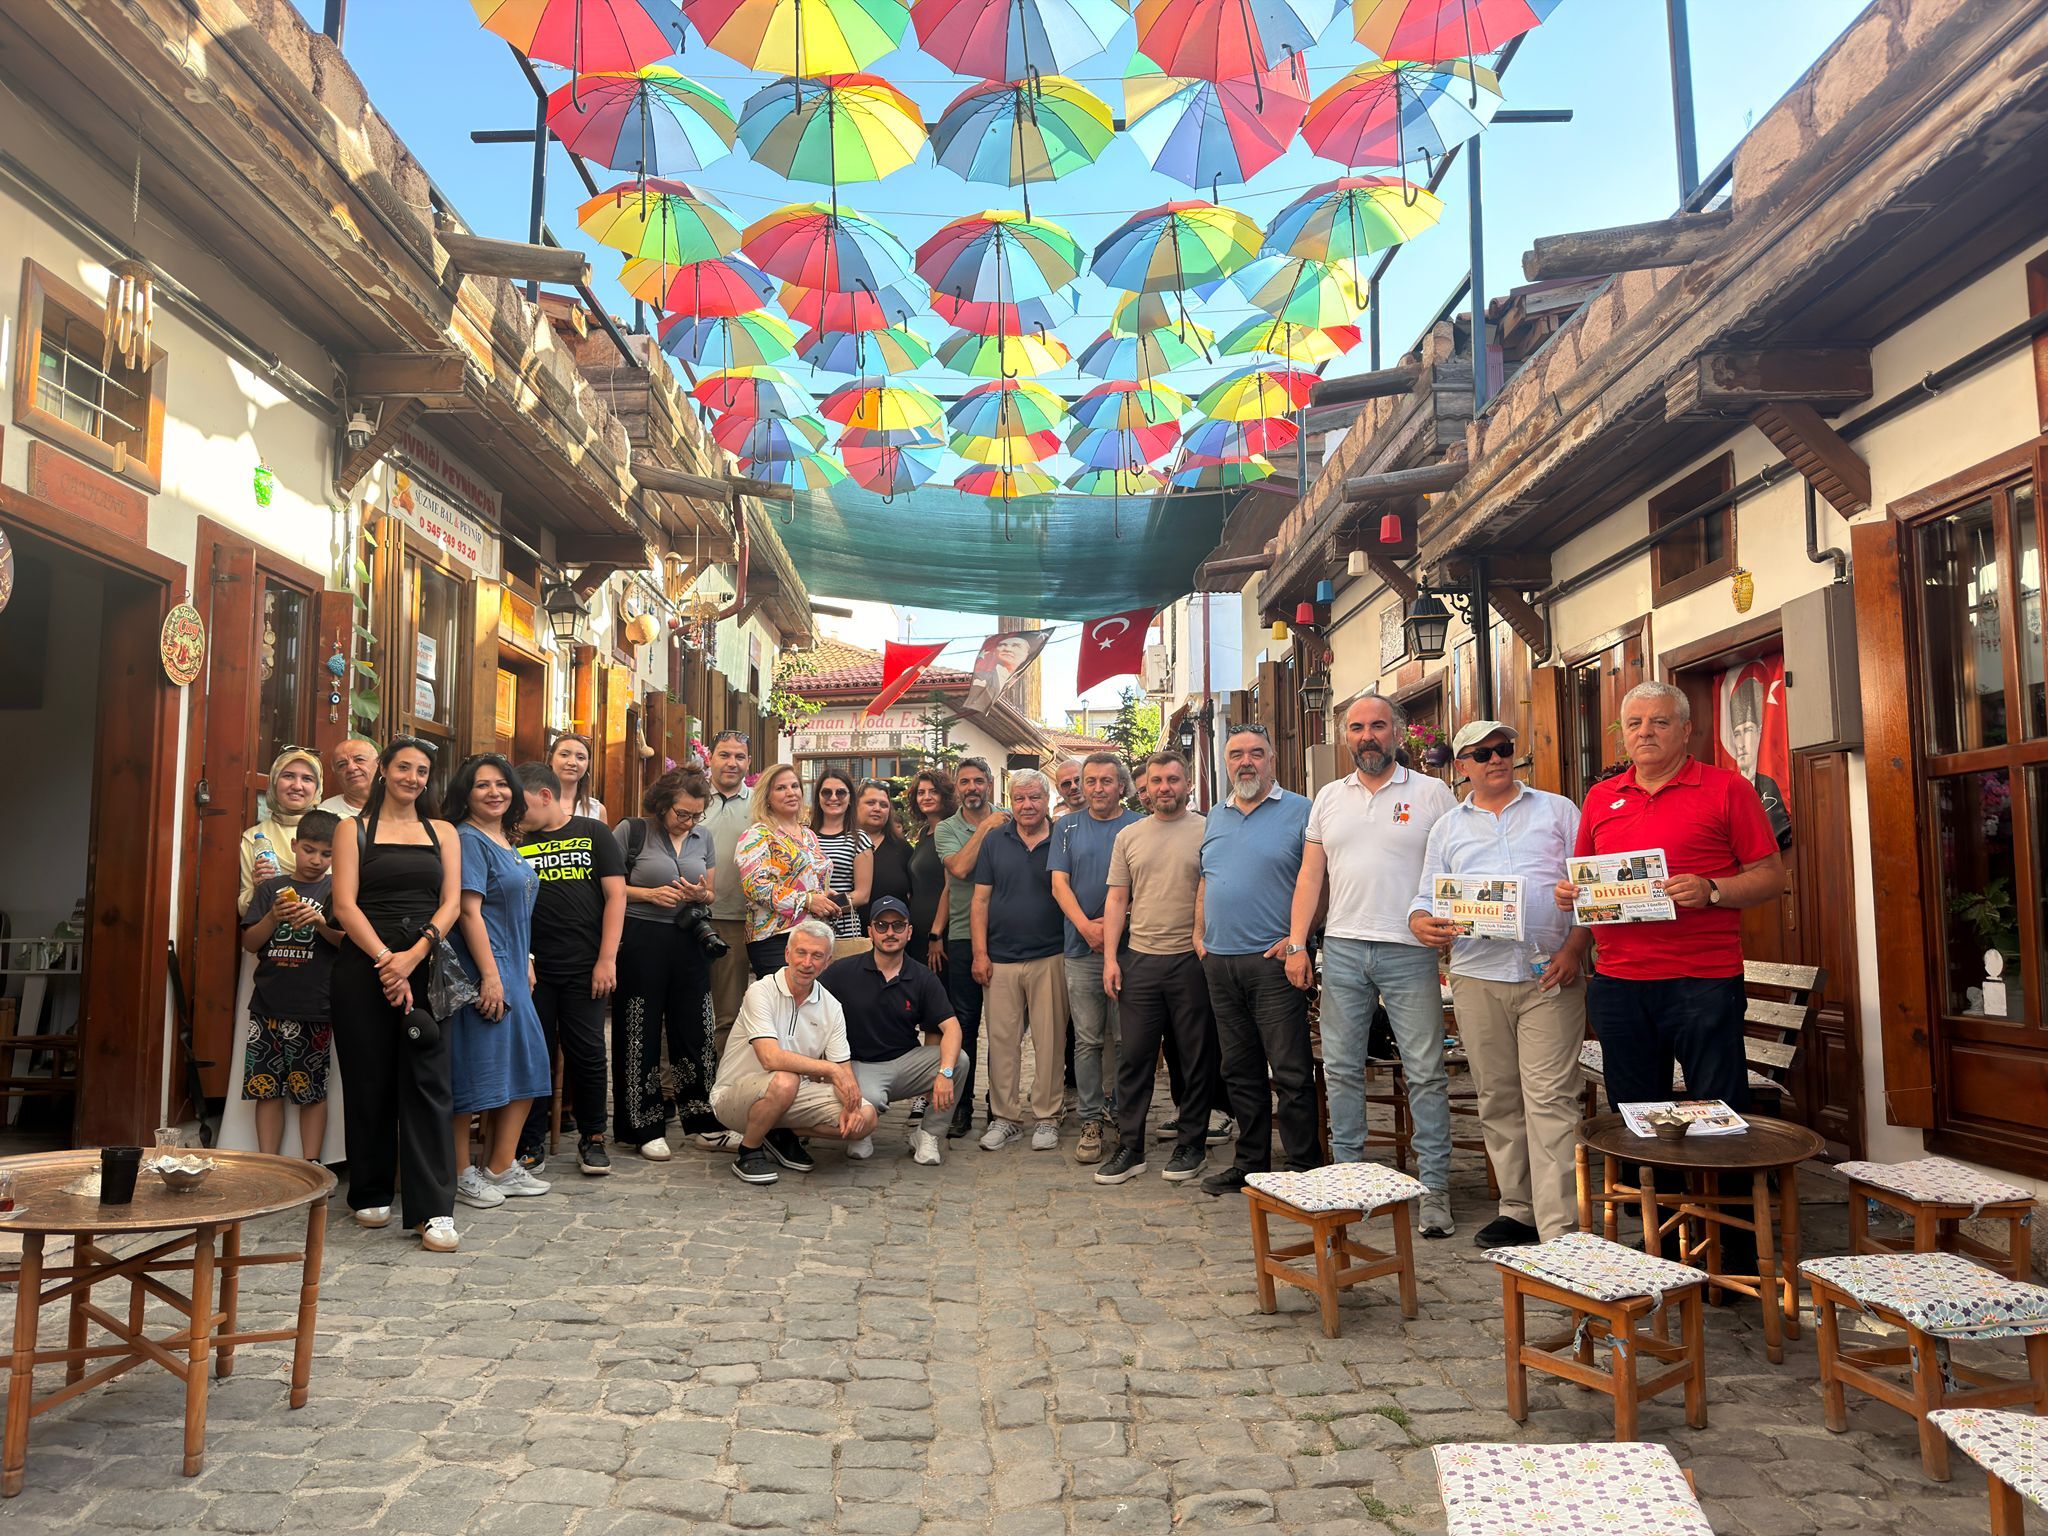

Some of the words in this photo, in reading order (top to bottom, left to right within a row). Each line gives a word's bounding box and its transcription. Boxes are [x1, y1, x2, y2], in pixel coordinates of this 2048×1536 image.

[442, 459, 496, 518] PEYNİRCİSİ
[415, 489, 439, 514] SÜZME
[440, 506, 454, 526] BAL
[460, 520, 482, 544] PEYNİR
[420, 516, 425, 528] 0
[427, 521, 441, 539] 545
[443, 531, 455, 548] 249
[458, 540, 467, 555] 93
[467, 547, 476, 561] 20
[532, 851, 591, 868] RIDERS
[1594, 883, 1647, 899] DİVRİĞİ
[1453, 904, 1499, 916] DİVRİĞİ
[267, 949, 314, 959] BROOKLYN
